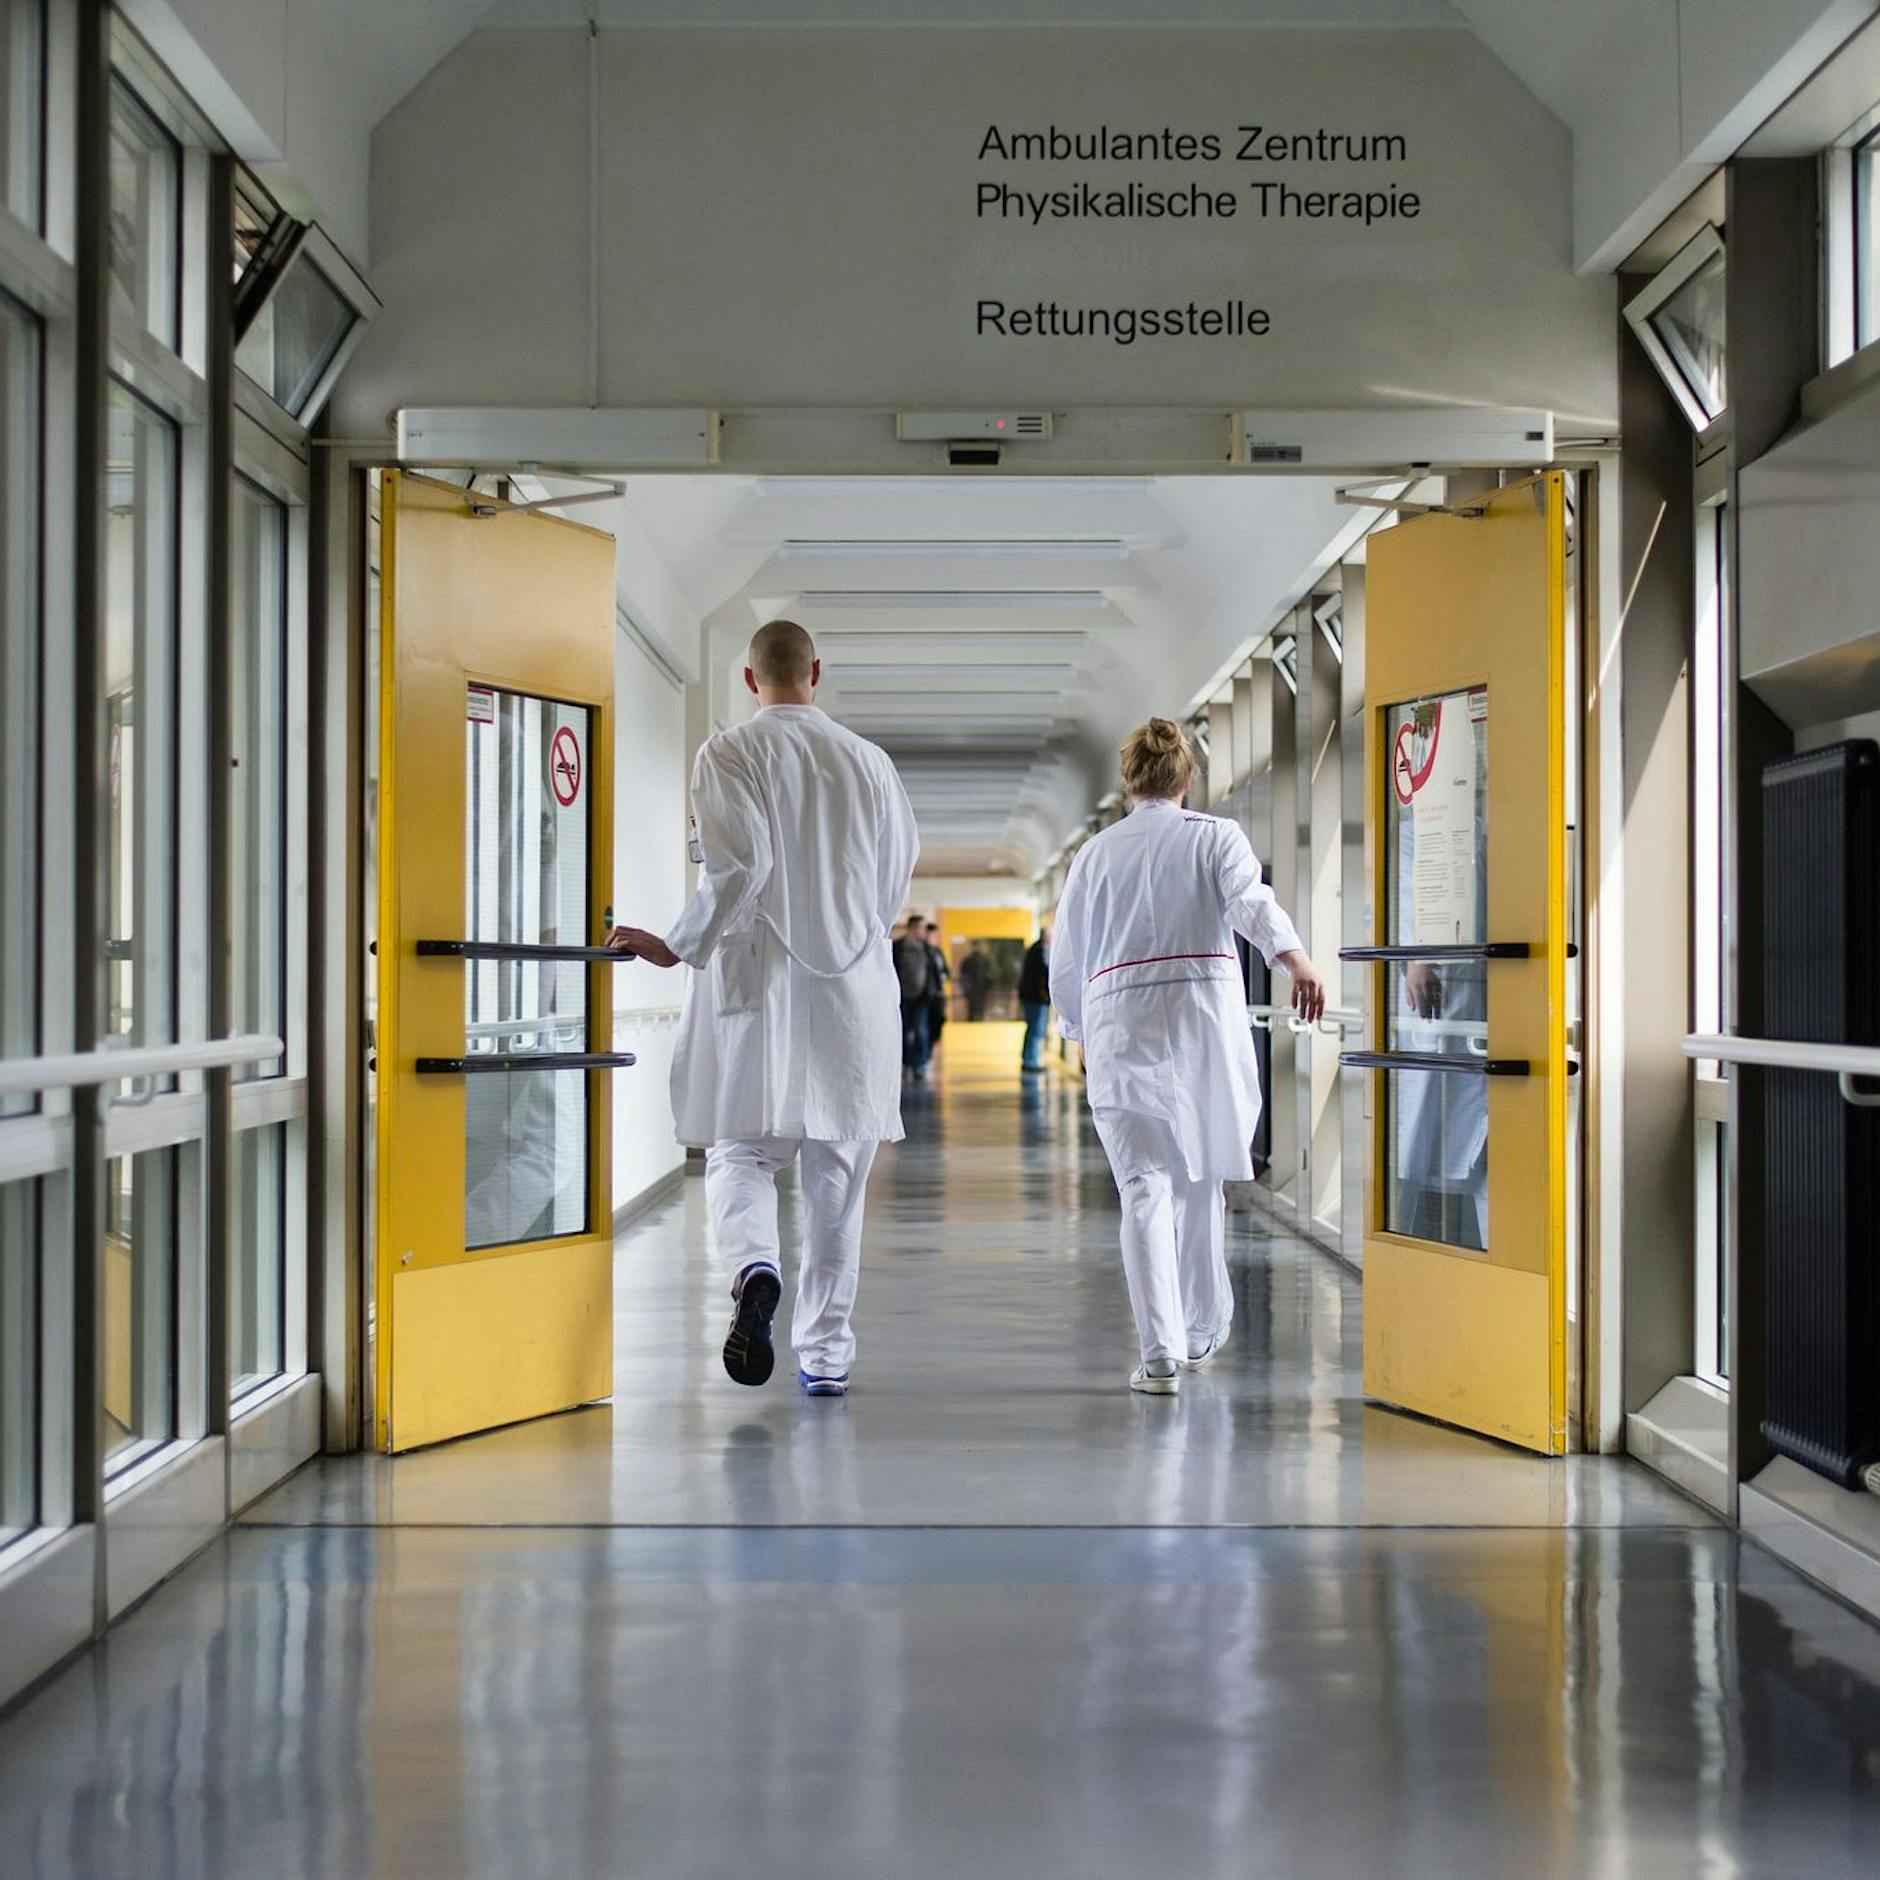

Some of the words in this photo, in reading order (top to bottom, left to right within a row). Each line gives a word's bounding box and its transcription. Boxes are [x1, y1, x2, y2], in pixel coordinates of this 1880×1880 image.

[978, 125, 1221, 161] Ambulantes
[1236, 126, 1406, 161] Zentrum
[977, 183, 1236, 225] Physikalische
[1251, 183, 1420, 226] Therapie
[977, 300, 1270, 345] Rettungsstelle
